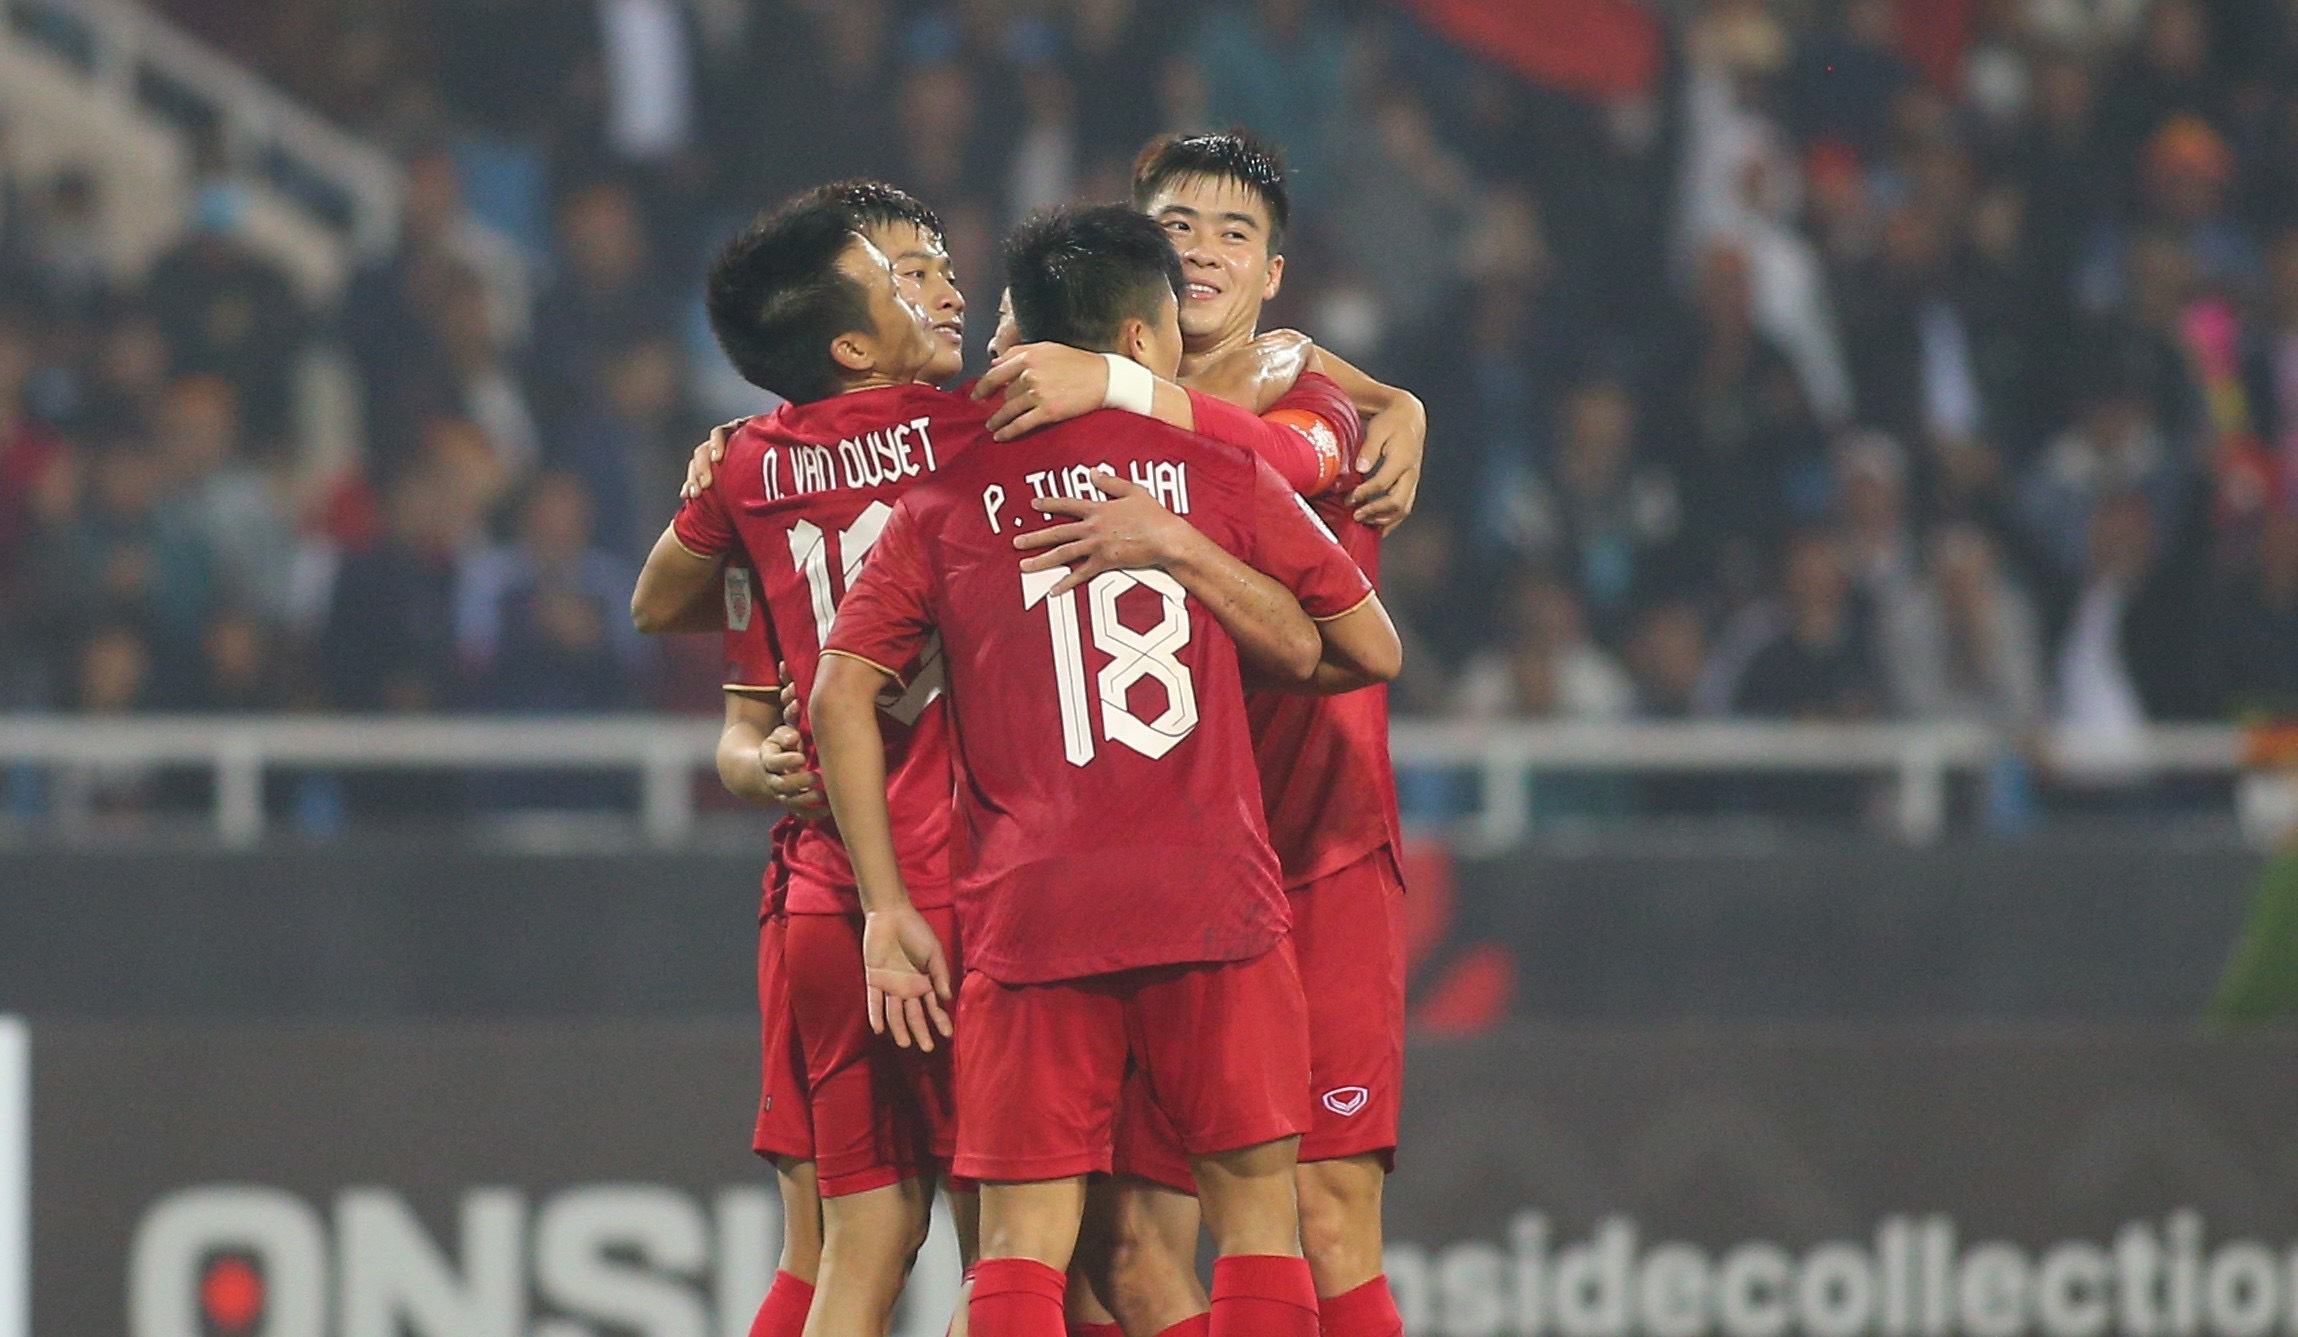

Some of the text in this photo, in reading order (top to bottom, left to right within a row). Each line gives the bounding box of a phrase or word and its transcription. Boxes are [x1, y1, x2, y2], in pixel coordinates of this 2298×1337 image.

[789, 443, 838, 496] VAN
[982, 483, 1025, 534] P.
[1127, 459, 1191, 514] HAI
[1019, 566, 1200, 767] 18
[1383, 1208, 2298, 1337] nsidecollectio
